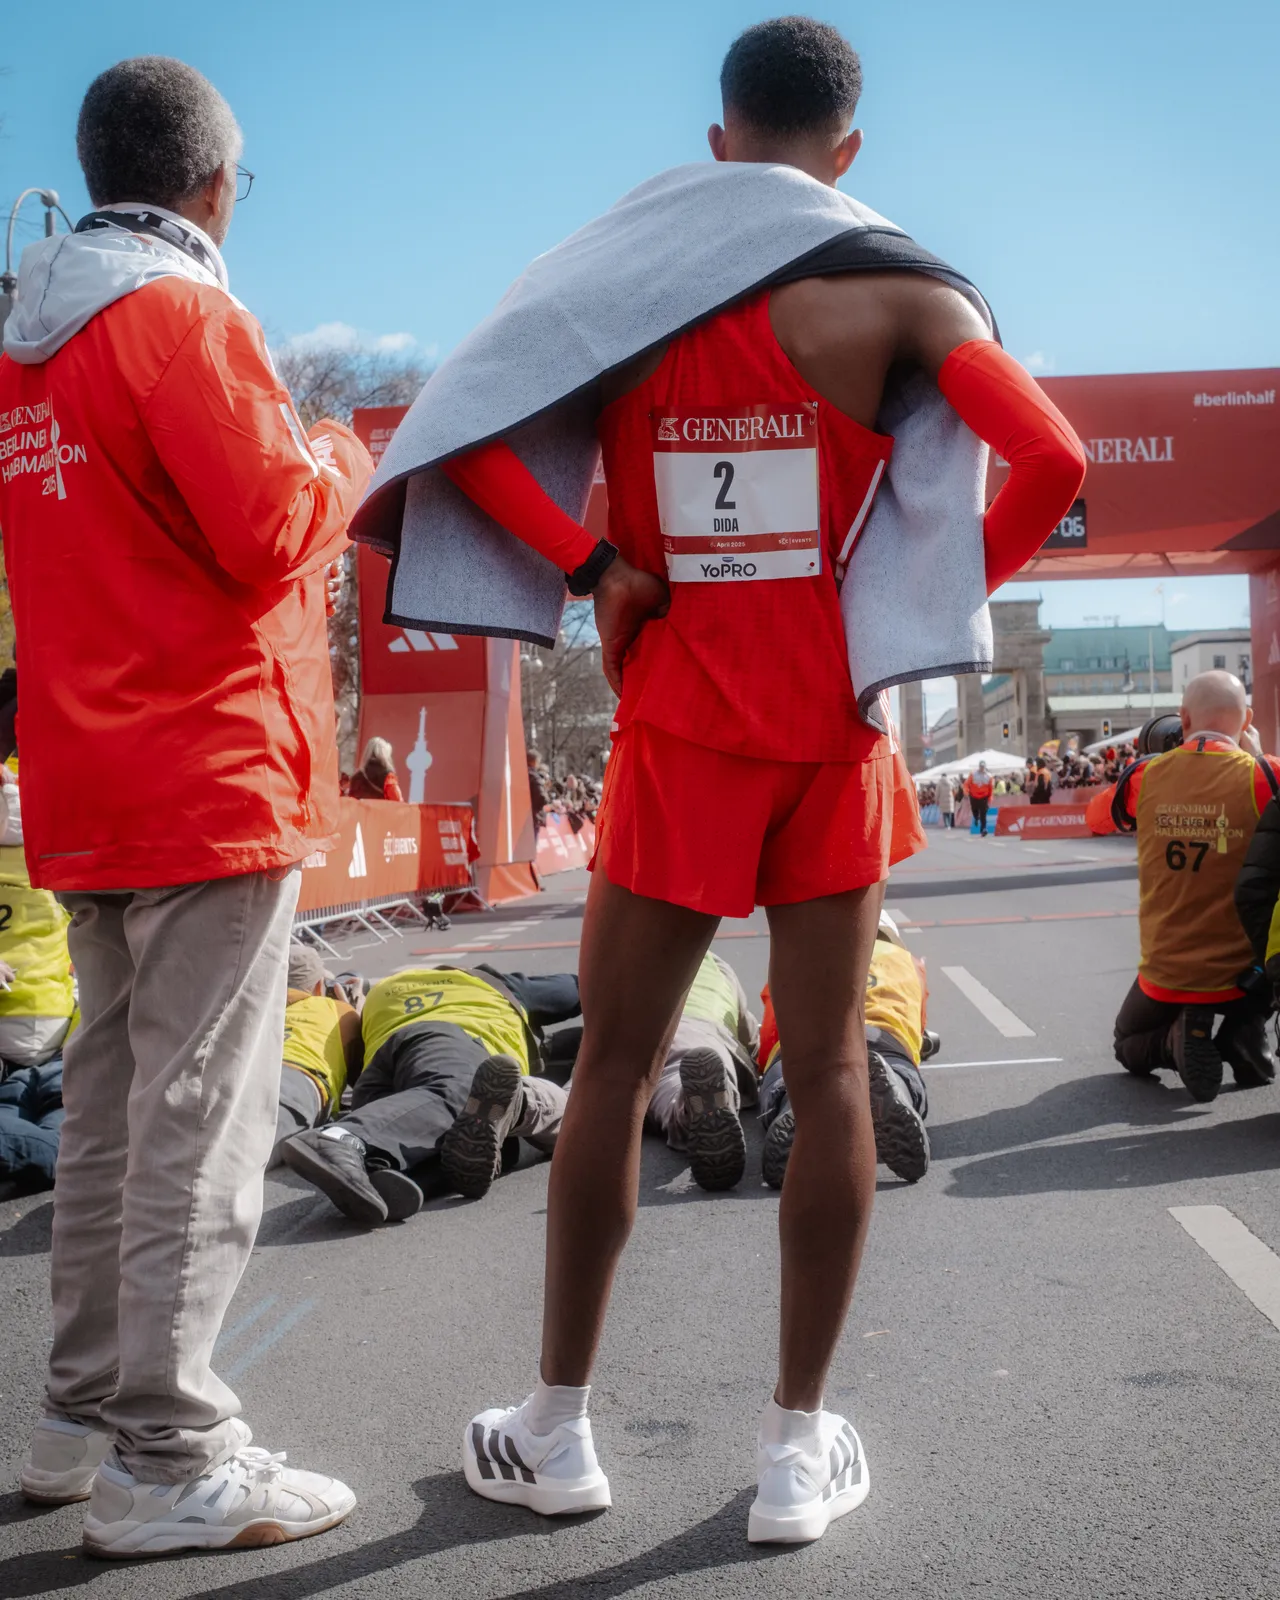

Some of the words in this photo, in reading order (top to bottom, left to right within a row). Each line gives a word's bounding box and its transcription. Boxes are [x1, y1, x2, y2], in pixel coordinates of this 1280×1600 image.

[1193, 389, 1275, 407] #berlinhalf
[683, 414, 804, 442] GENERALI
[1082, 436, 1175, 463] NERALI
[713, 461, 736, 510] 2
[713, 518, 739, 533] DIDA
[716, 541, 731, 549] April
[700, 563, 757, 578] YoPRO
[1168, 803, 1217, 814] GENERALI
[1042, 814, 1086, 827] GENERAL
[1166, 840, 1210, 873] 67
[404, 991, 444, 1014] 87
